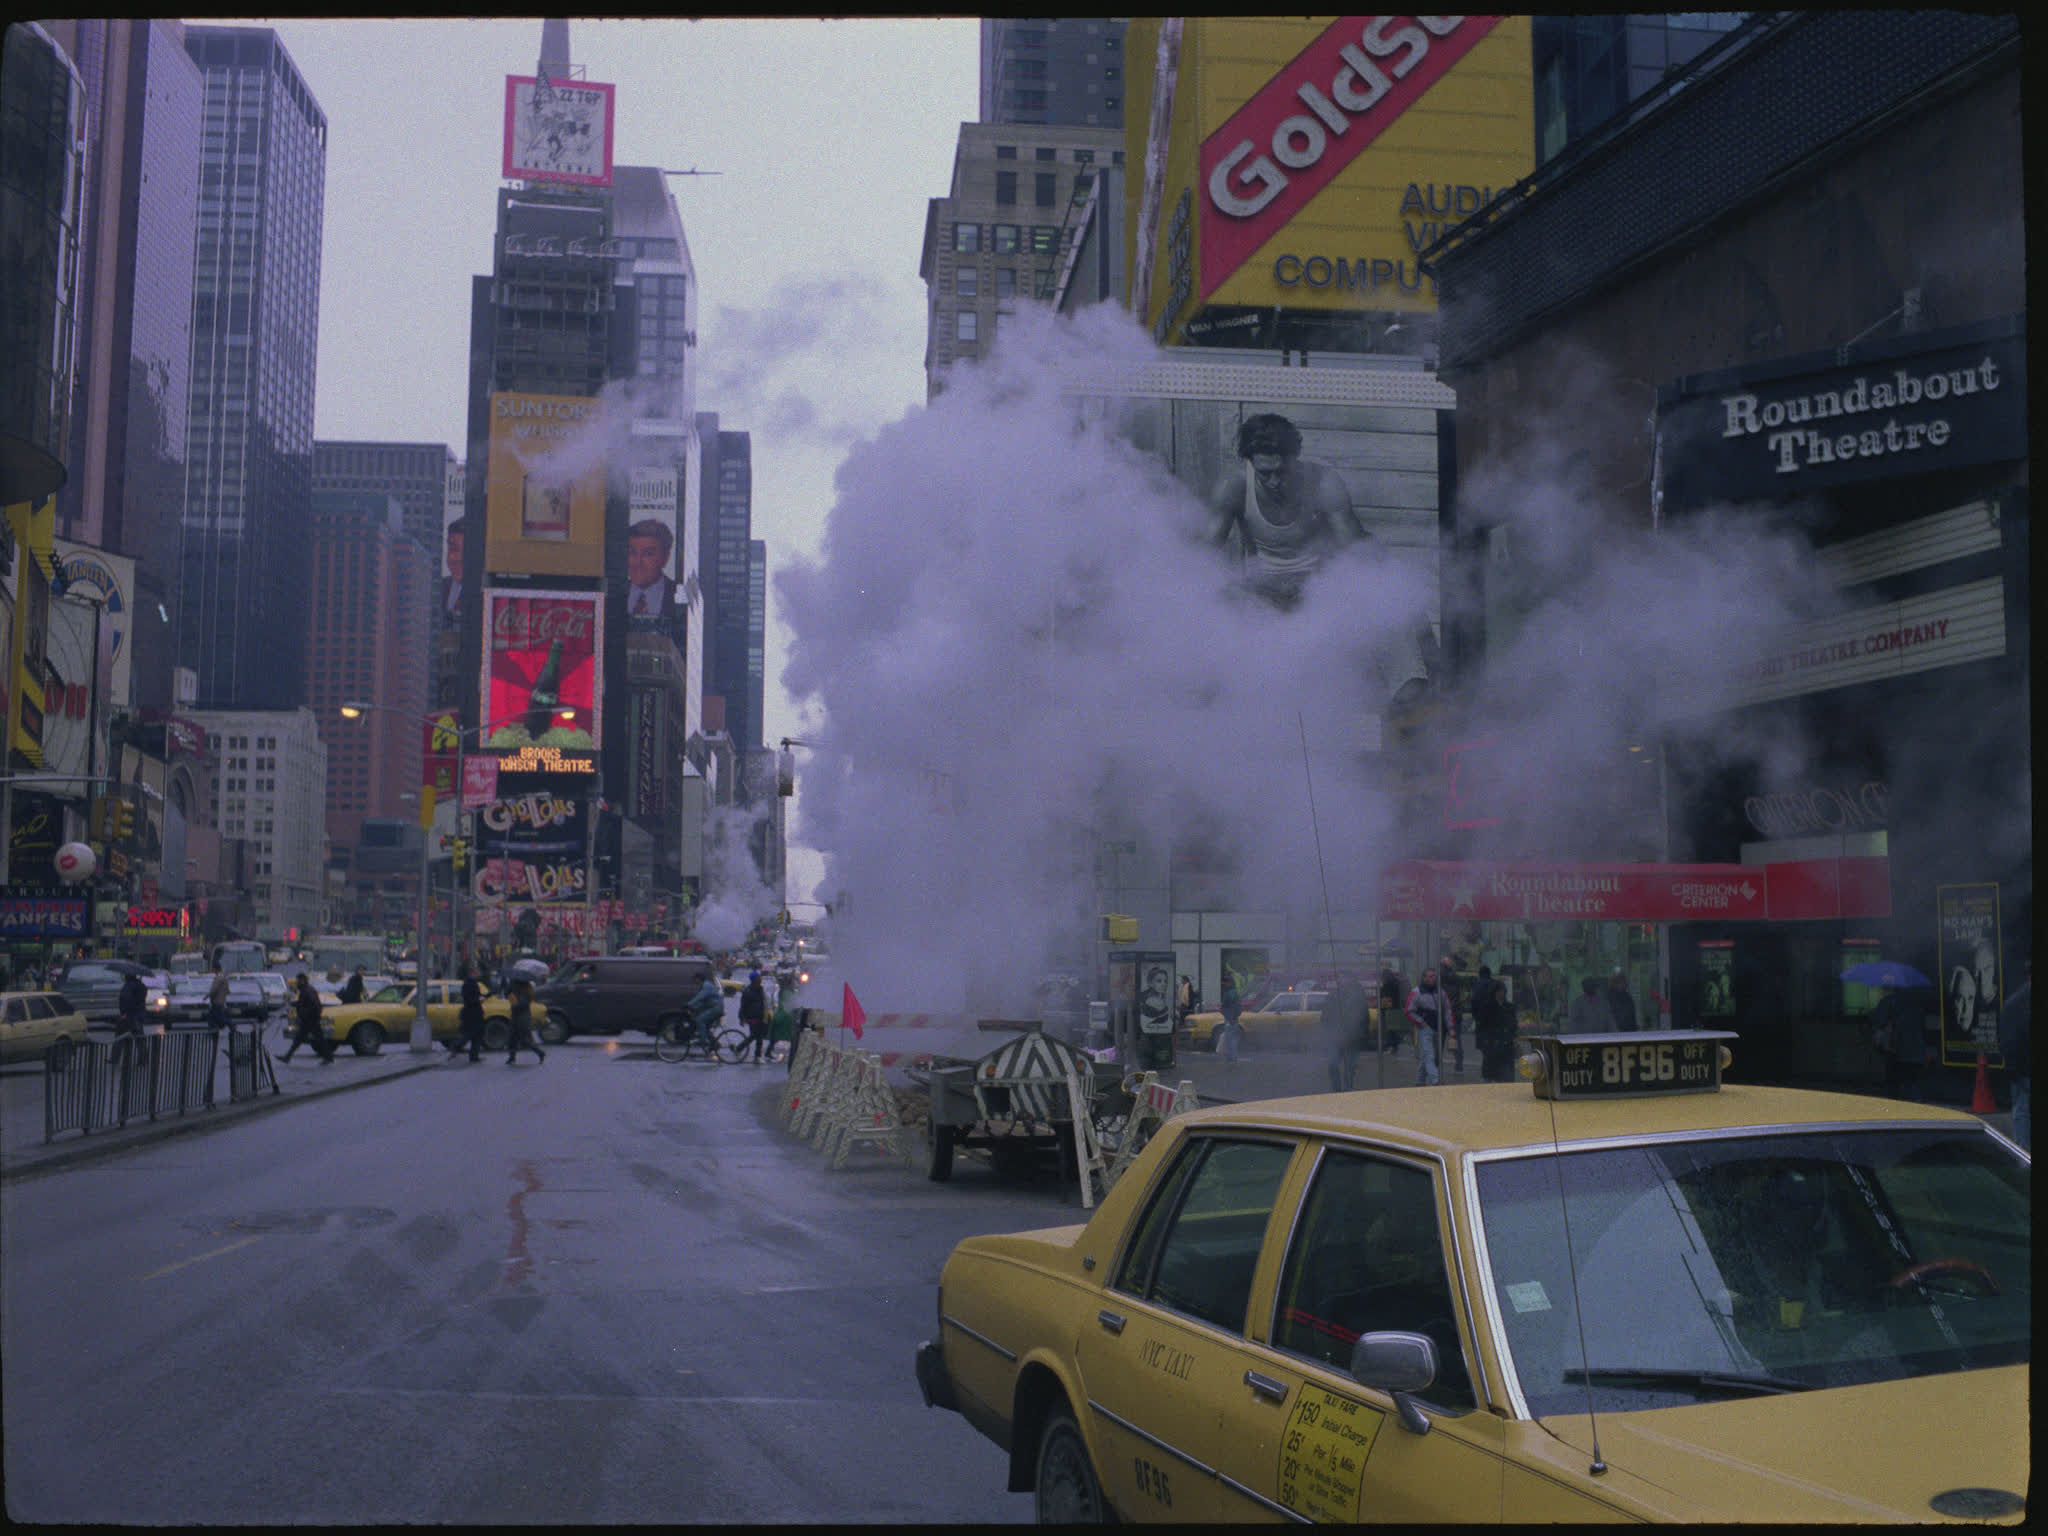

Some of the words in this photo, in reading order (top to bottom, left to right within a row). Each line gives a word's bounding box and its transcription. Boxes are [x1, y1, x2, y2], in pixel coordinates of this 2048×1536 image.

[1721, 356, 2000, 438] Roundabout
[1768, 418, 1951, 475] Theatre
[1791, 640, 1859, 672] THEATRE
[1864, 618, 1950, 655] COMPANY
[1491, 871, 1622, 896] Roundabout
[1671, 881, 1738, 897] CRITERION
[1523, 890, 1609, 919] Theatre
[1680, 896, 1729, 909] CENTER
[1566, 1047, 1592, 1065] OFF
[1682, 1042, 1707, 1060] OFF
[1602, 1044, 1675, 1084] 8F96
[1680, 1063, 1711, 1081] DUTY
[1562, 1069, 1594, 1087] DUTY
[1138, 1337, 1166, 1369] NYC
[1163, 1347, 1196, 1381] TAXI
[1340, 1424, 1368, 1447] Charge
